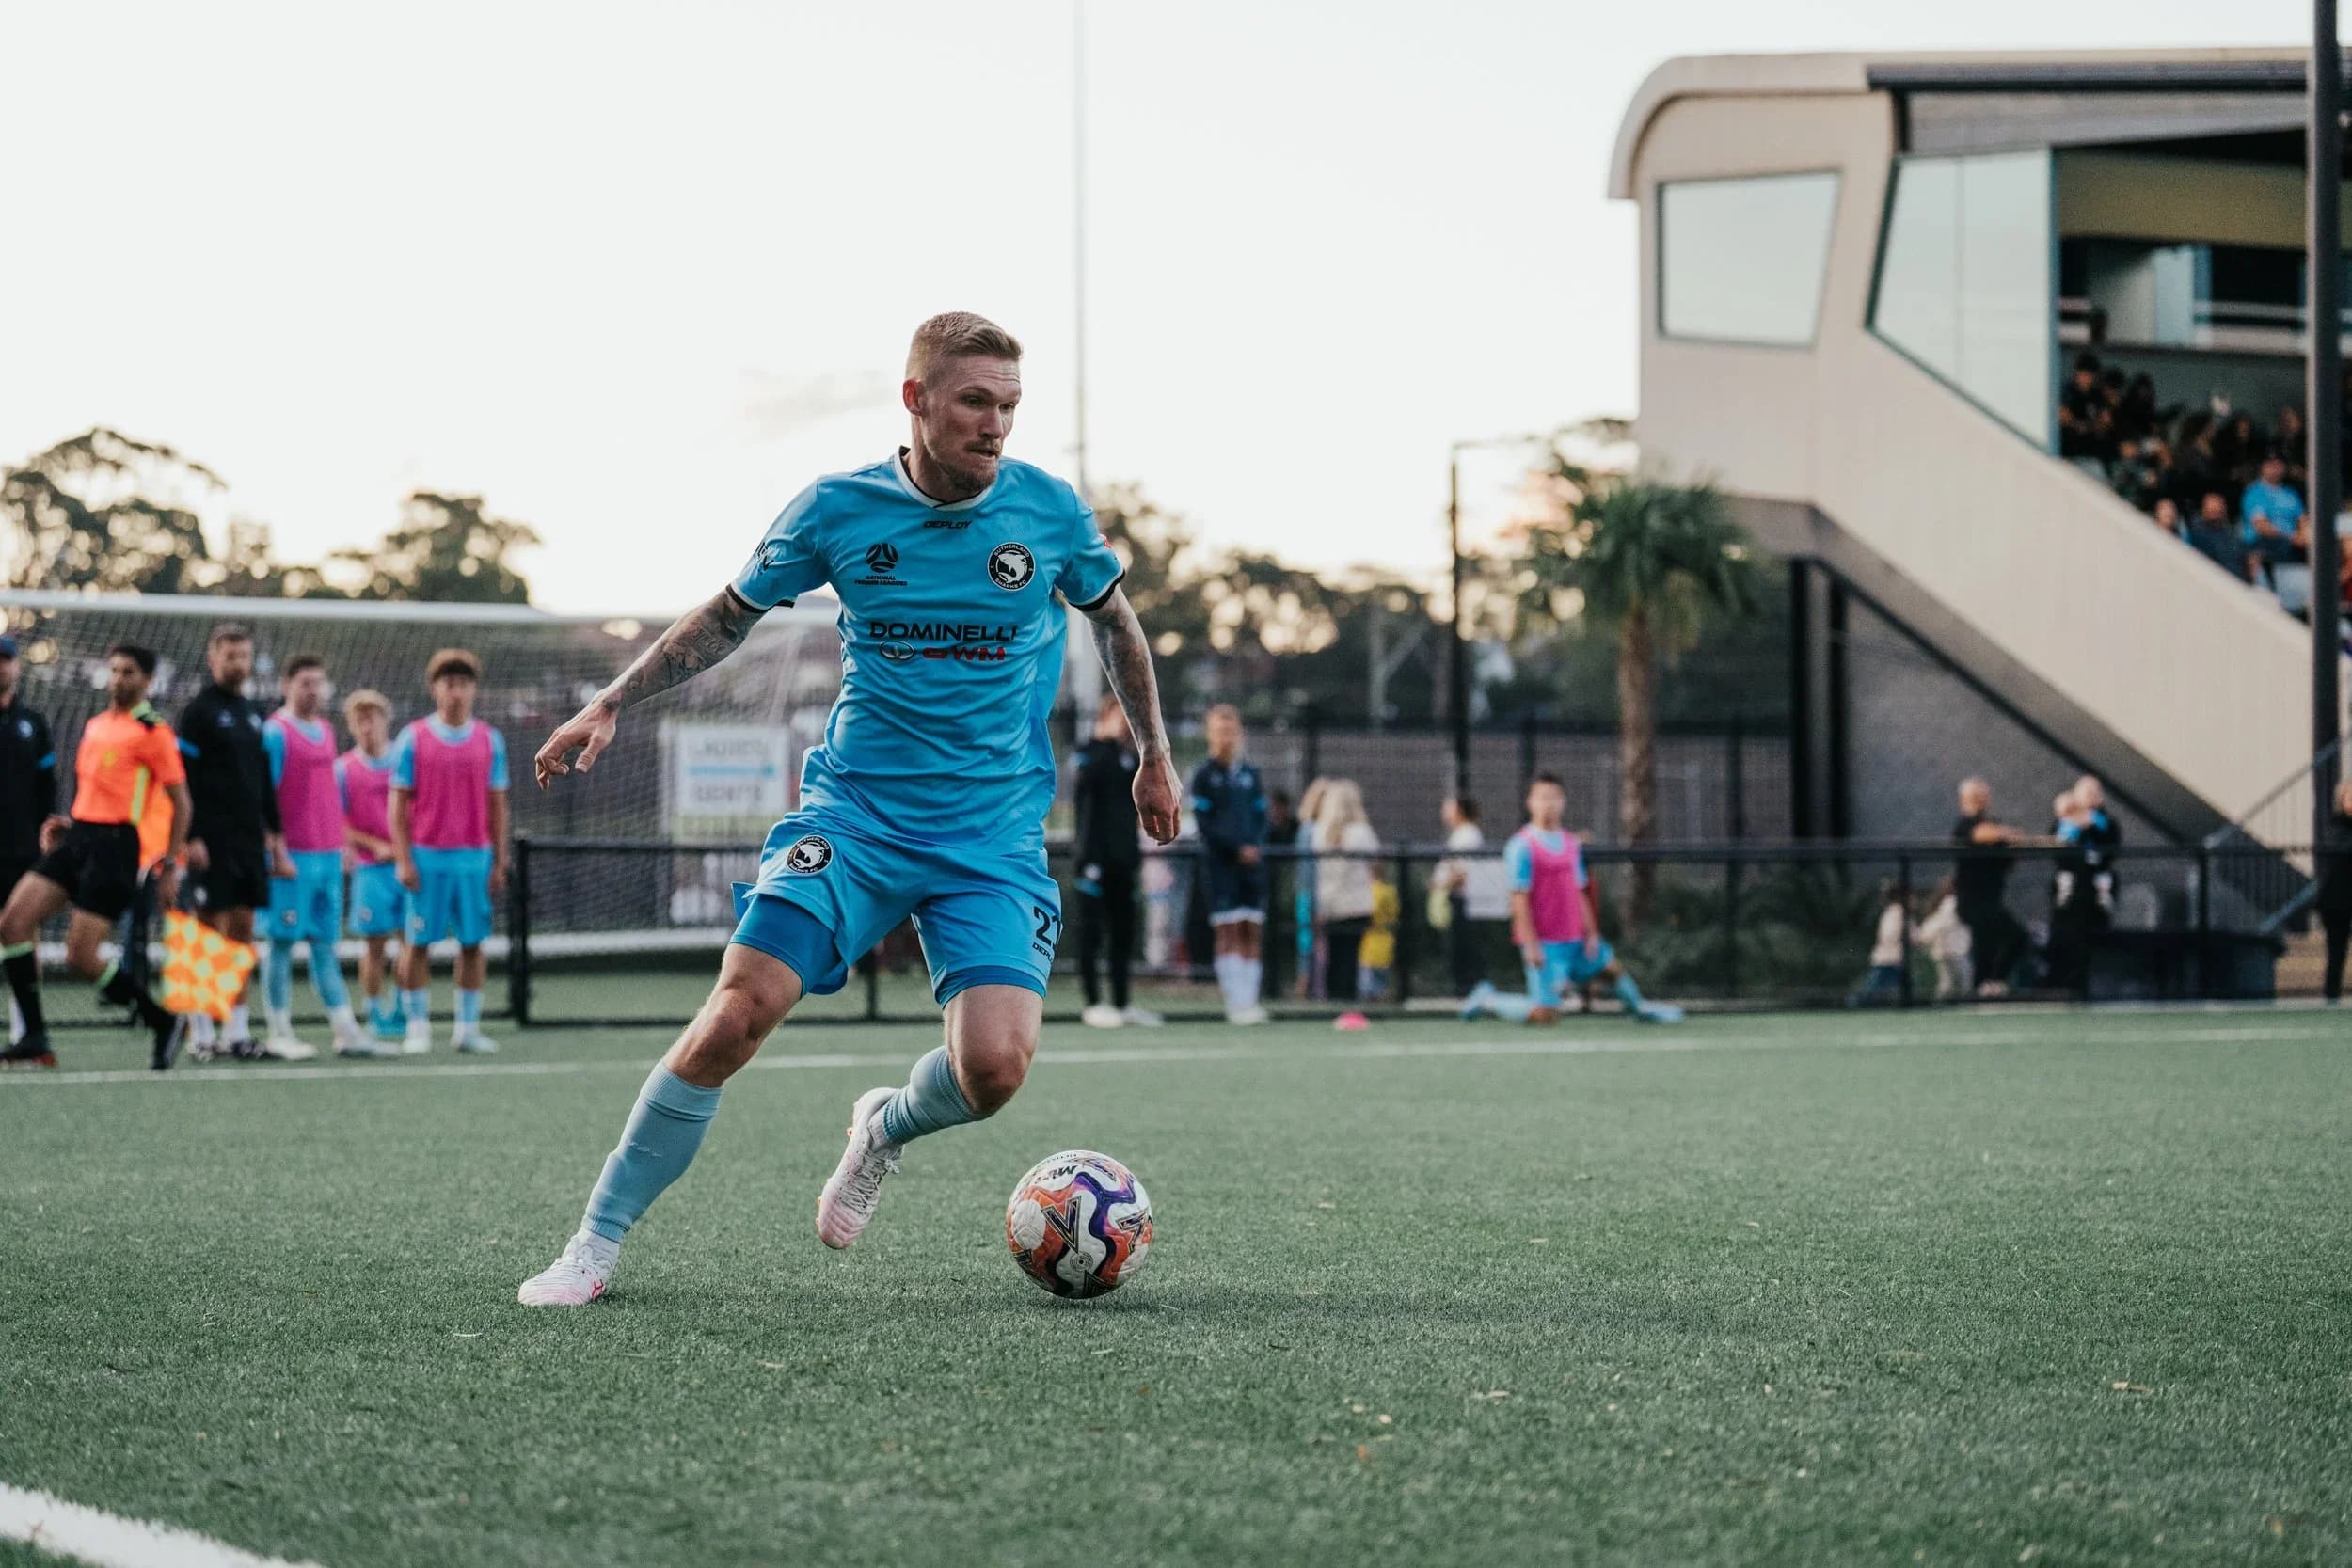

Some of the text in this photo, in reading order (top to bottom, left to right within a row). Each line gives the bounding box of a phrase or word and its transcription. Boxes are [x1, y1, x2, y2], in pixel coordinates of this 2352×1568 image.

[993, 544, 1030, 558] SUTHERLAND
[994, 578, 1019, 589] SHARKS
[869, 621, 1019, 641] DOMINELLI
